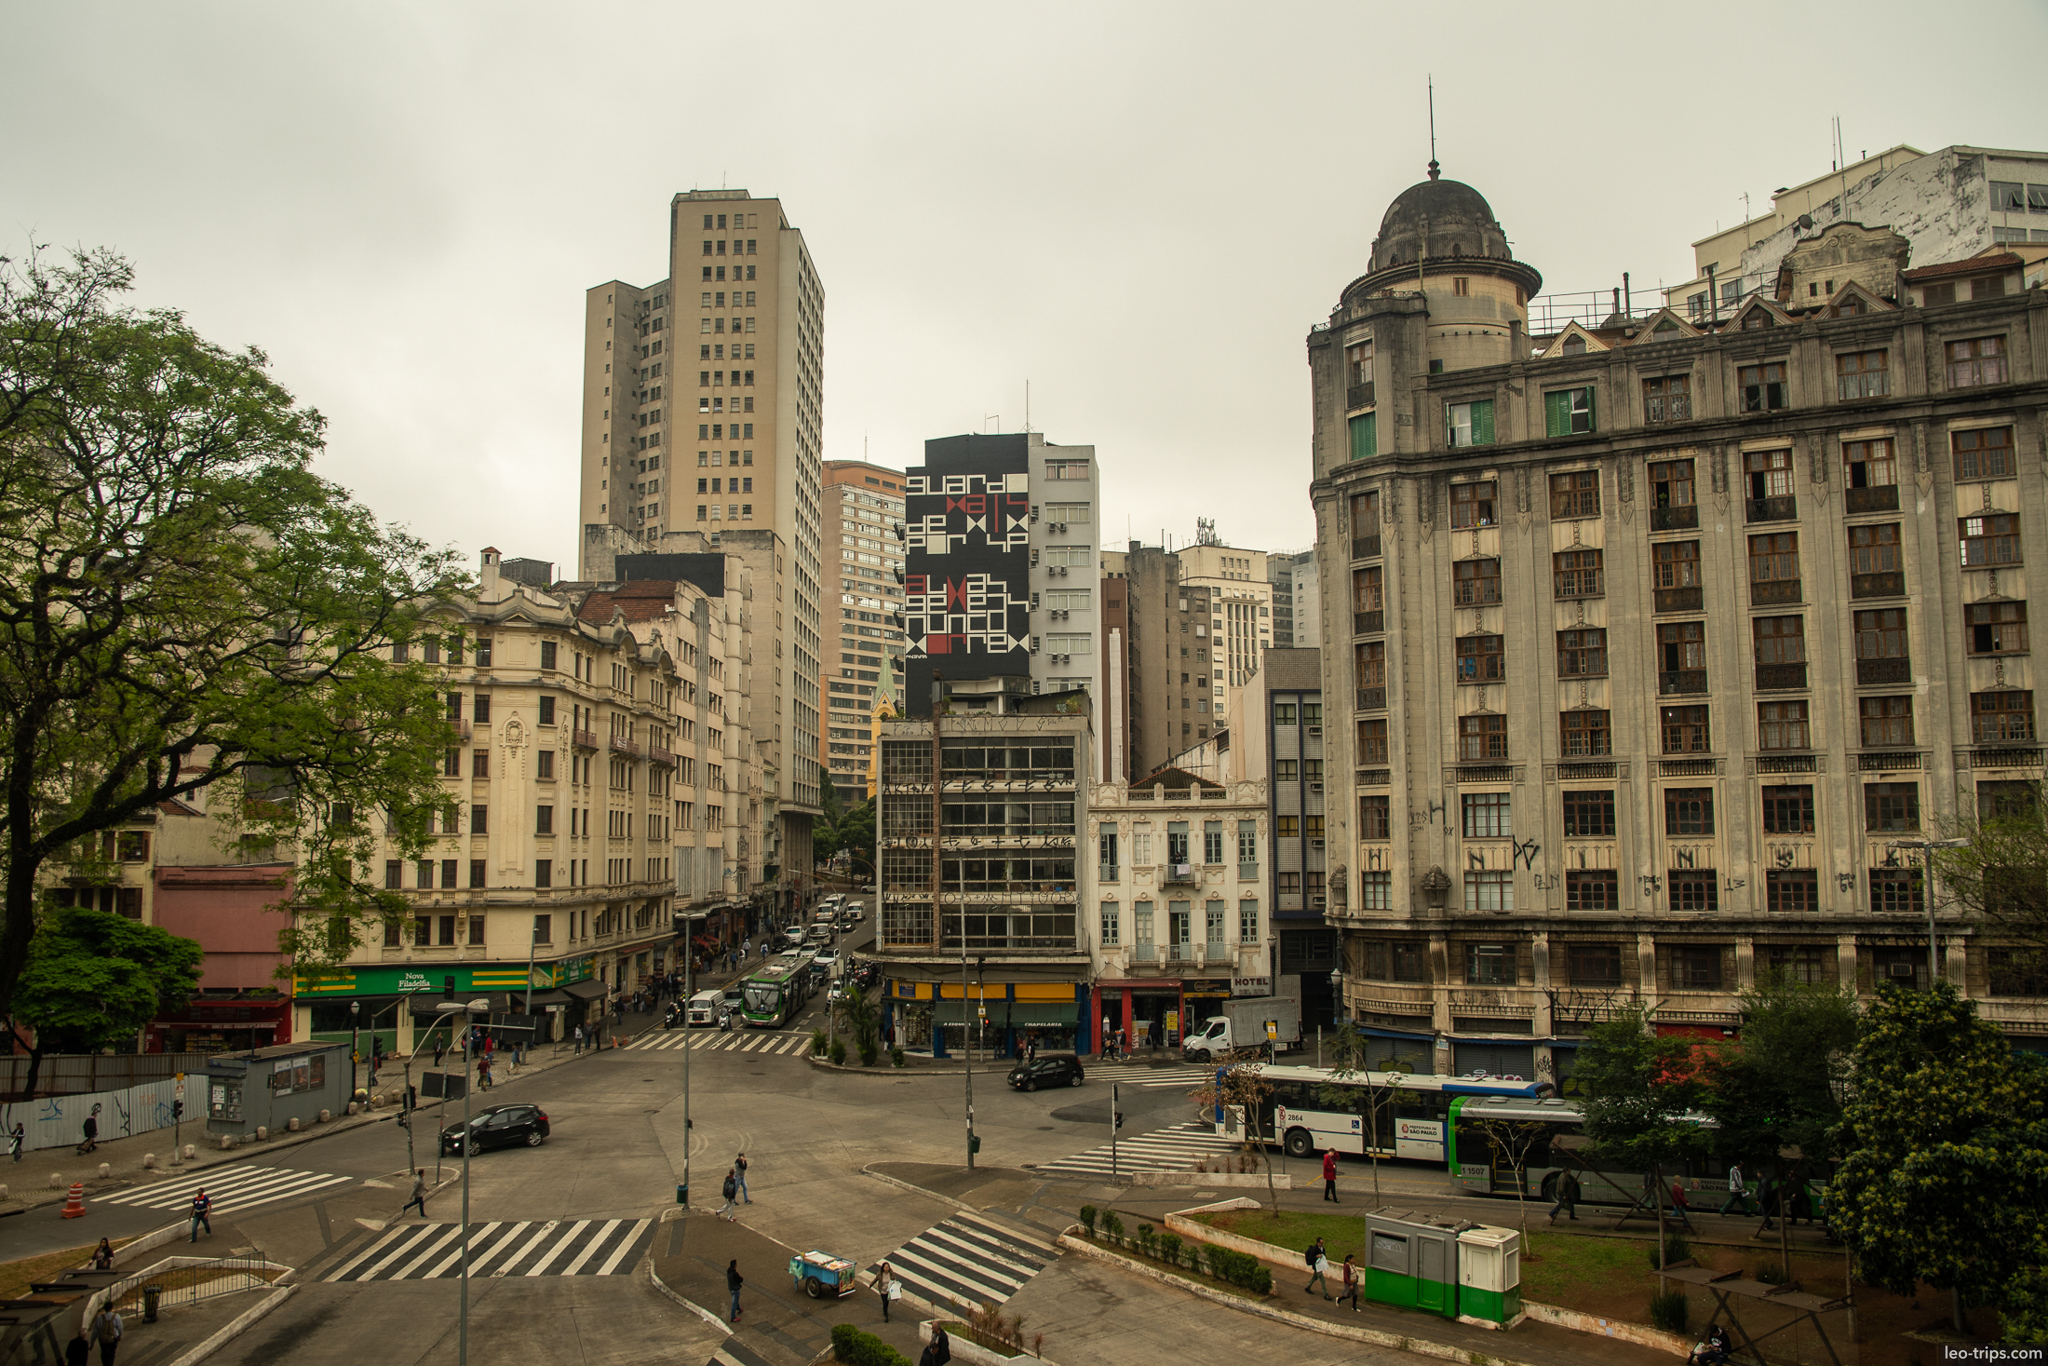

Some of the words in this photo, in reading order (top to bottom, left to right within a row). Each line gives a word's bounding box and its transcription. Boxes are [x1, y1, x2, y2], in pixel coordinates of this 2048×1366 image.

[1235, 978, 1268, 986] HOTEL
[1288, 1114, 1303, 1122] 2864
[1467, 1167, 1485, 1175] 1507
